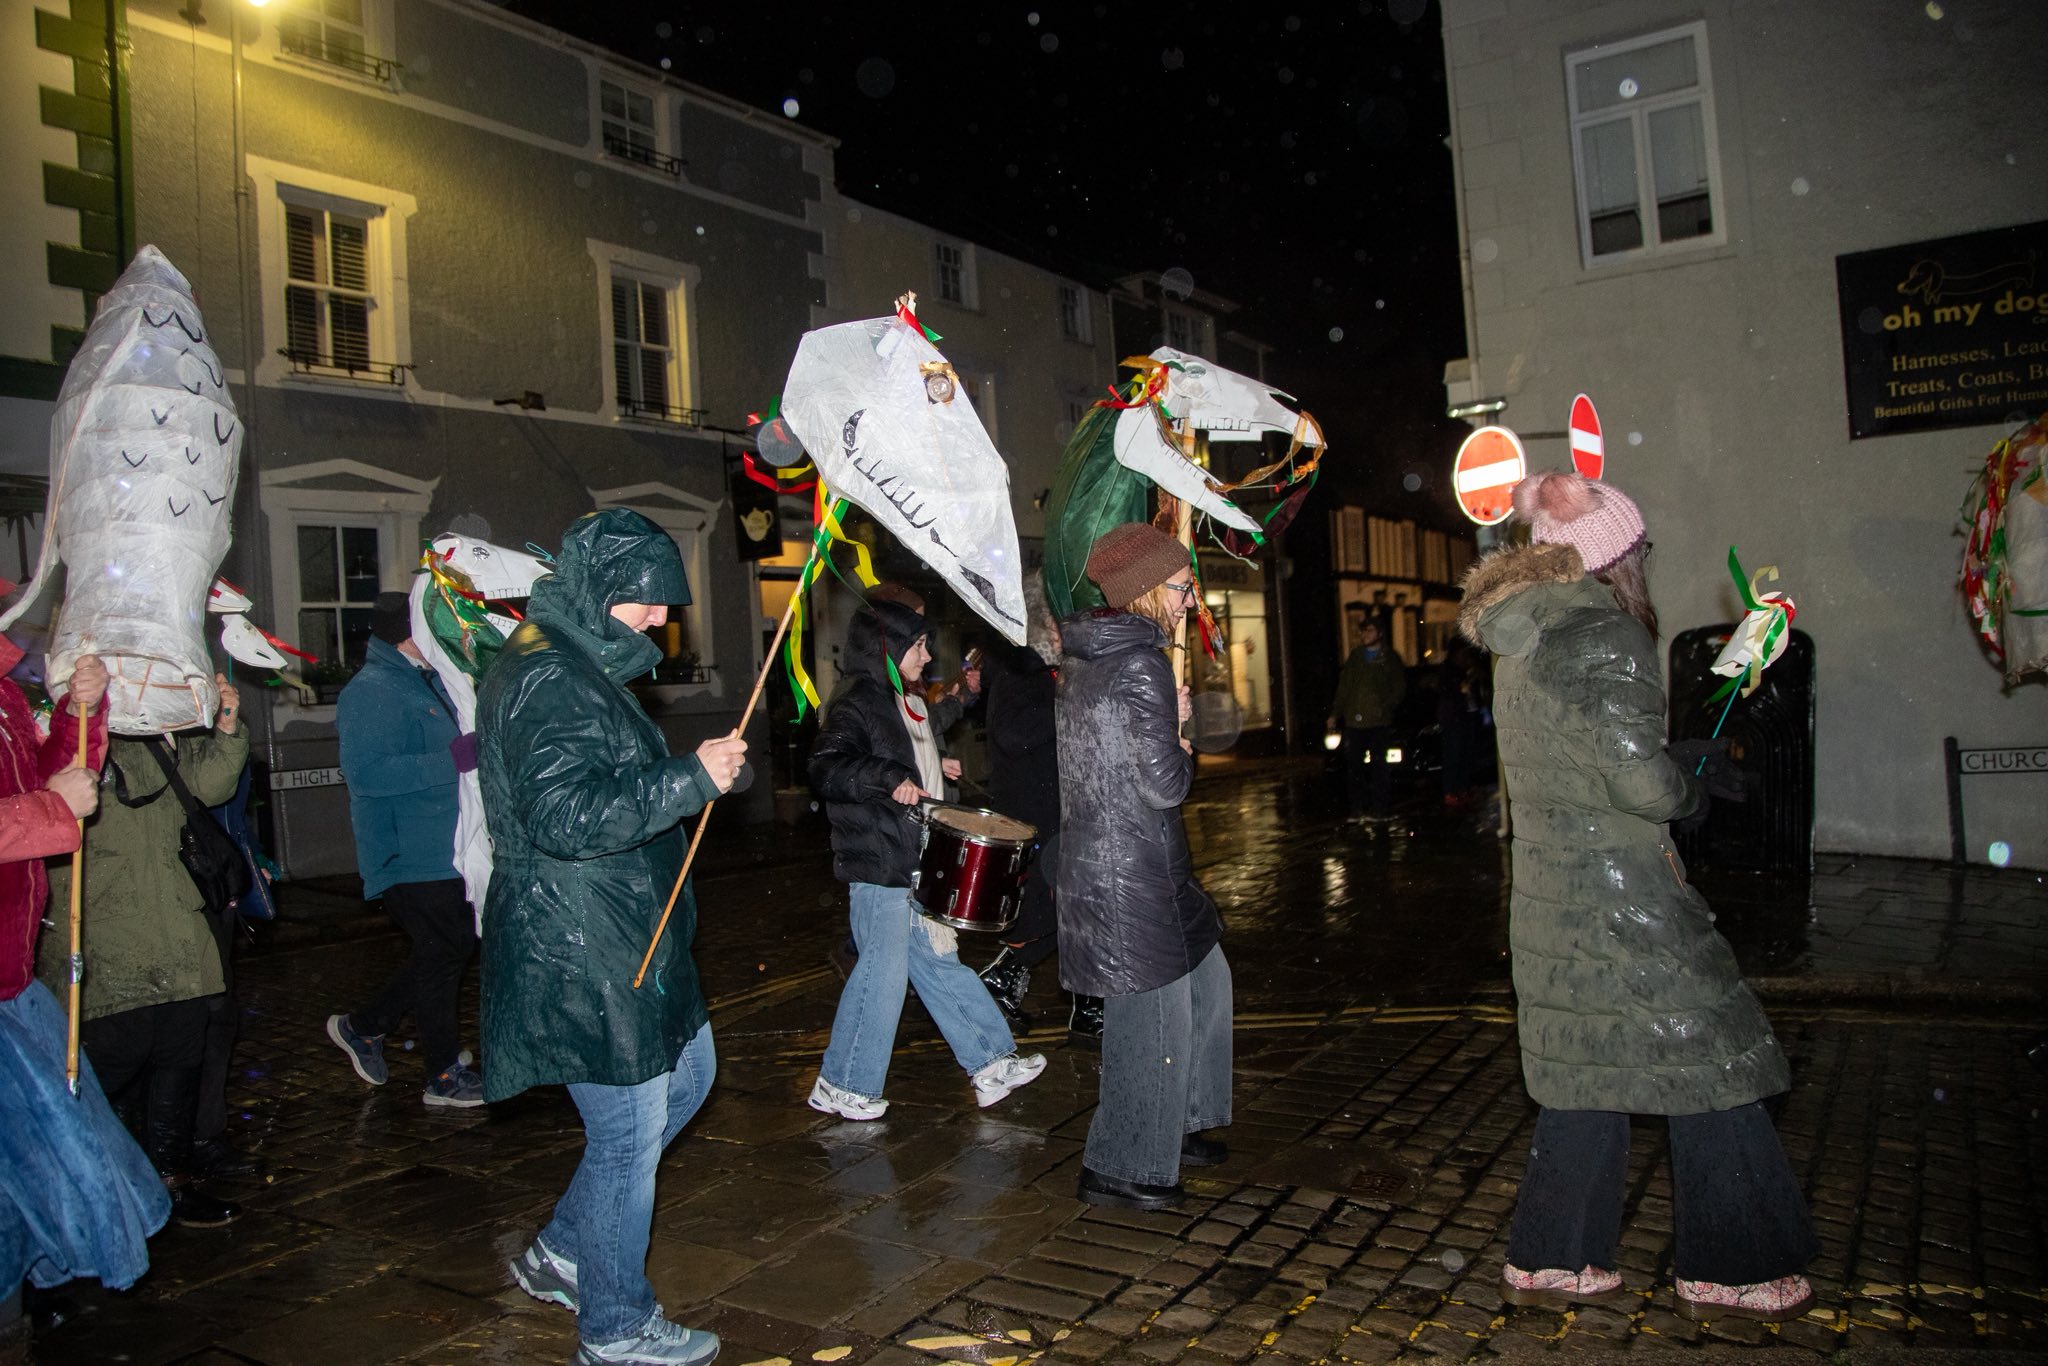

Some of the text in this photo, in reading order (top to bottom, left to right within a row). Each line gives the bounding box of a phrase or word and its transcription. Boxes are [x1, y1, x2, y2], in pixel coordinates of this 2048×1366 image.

[1882, 290, 2048, 331] oh my dog
[1873, 401, 1935, 419] Beautiful
[1939, 396, 1974, 411] Gifts
[1978, 394, 2001, 407] For
[292, 770, 330, 787] HIGH
